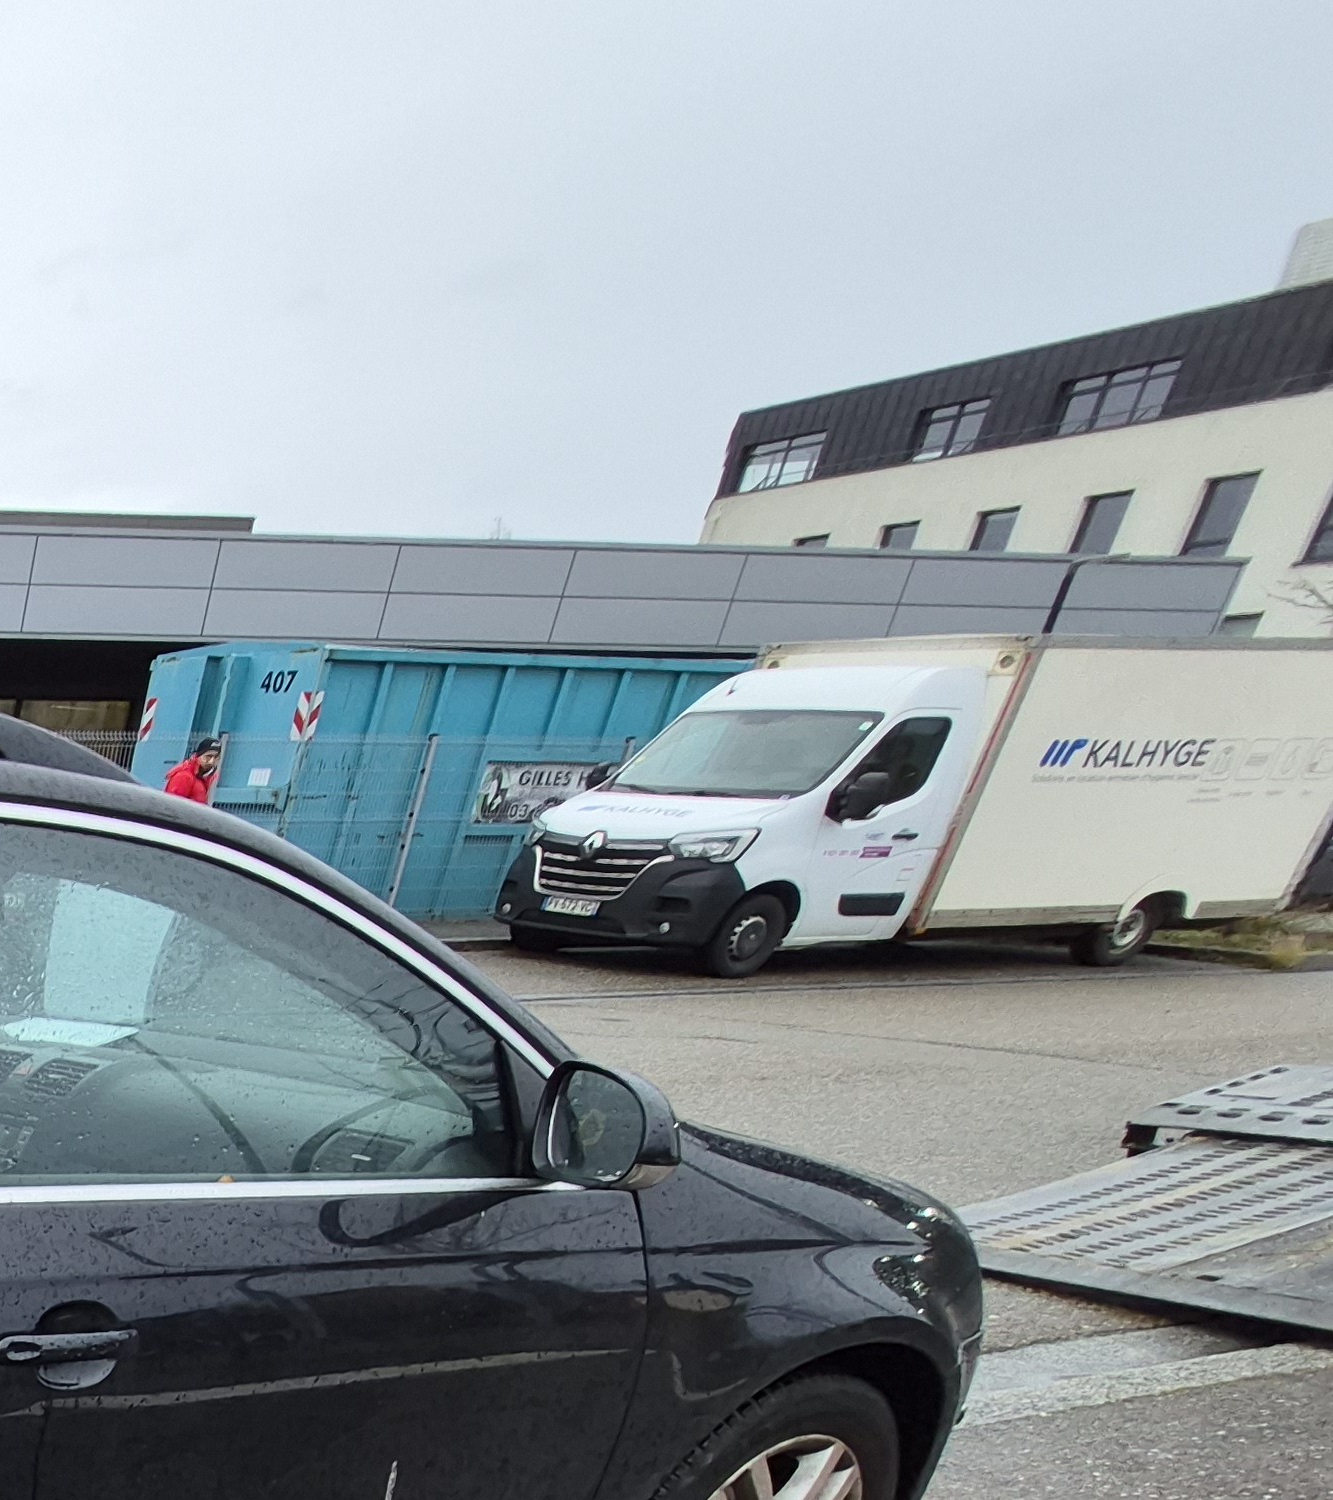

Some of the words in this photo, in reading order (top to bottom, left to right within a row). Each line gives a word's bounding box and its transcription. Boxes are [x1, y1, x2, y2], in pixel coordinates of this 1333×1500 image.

[260, 670, 299, 693] 407
[1082, 739, 1217, 768] KALHYGE
[518, 769, 573, 786] GILLES
